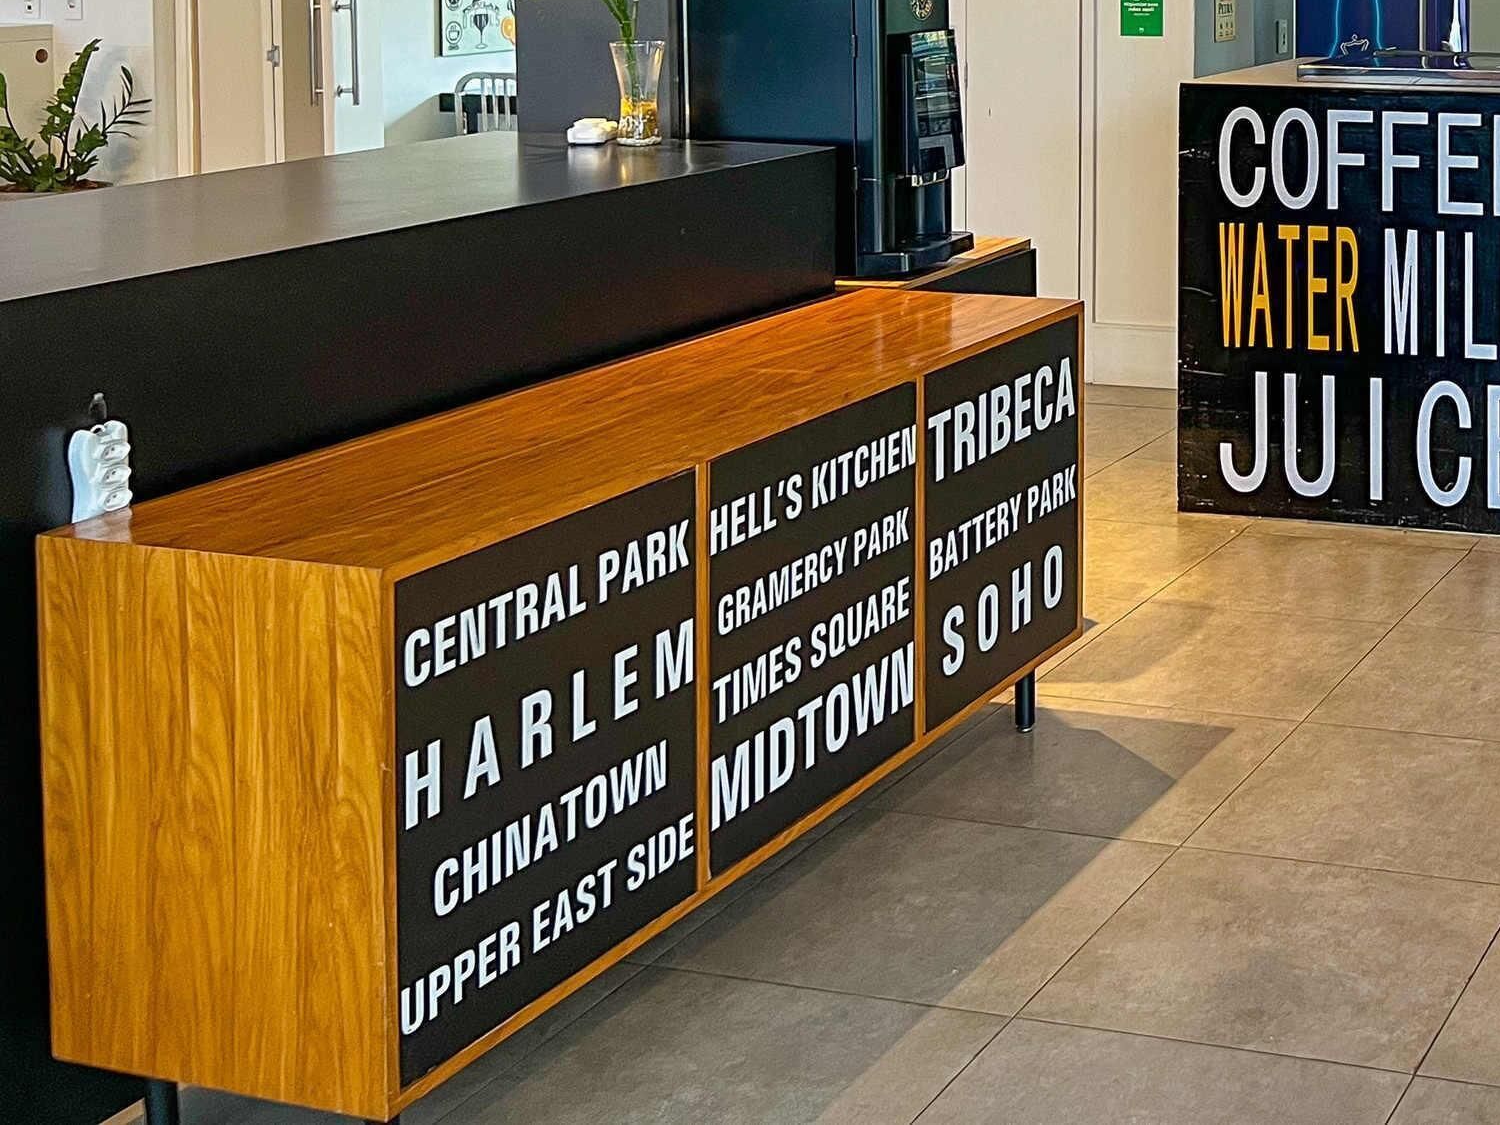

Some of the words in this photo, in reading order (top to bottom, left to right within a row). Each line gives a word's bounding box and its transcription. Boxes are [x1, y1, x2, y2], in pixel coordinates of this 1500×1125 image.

[1218, 221, 1360, 353] WATER
[928, 357, 1076, 482] TRIBECA
[709, 473, 802, 556] HELL'S
[811, 424, 917, 509] KITCHEN
[928, 490, 1021, 580] BATTERY
[1027, 464, 1077, 525] PARK
[403, 564, 586, 689] CENTRAL
[597, 519, 691, 605] PARK
[717, 550, 847, 636] GRAMERCY
[852, 507, 909, 569] PARK
[942, 545, 1064, 676] SOHO
[712, 636, 801, 724] TIMES
[809, 576, 910, 669] SQUARE
[403, 617, 695, 831] HARLEM
[710, 641, 915, 832] MIDTOWN
[434, 738, 668, 917] CHINATOWN
[400, 921, 521, 1037] UPPER
[532, 860, 617, 955] EAST
[626, 812, 695, 893] SIDE
